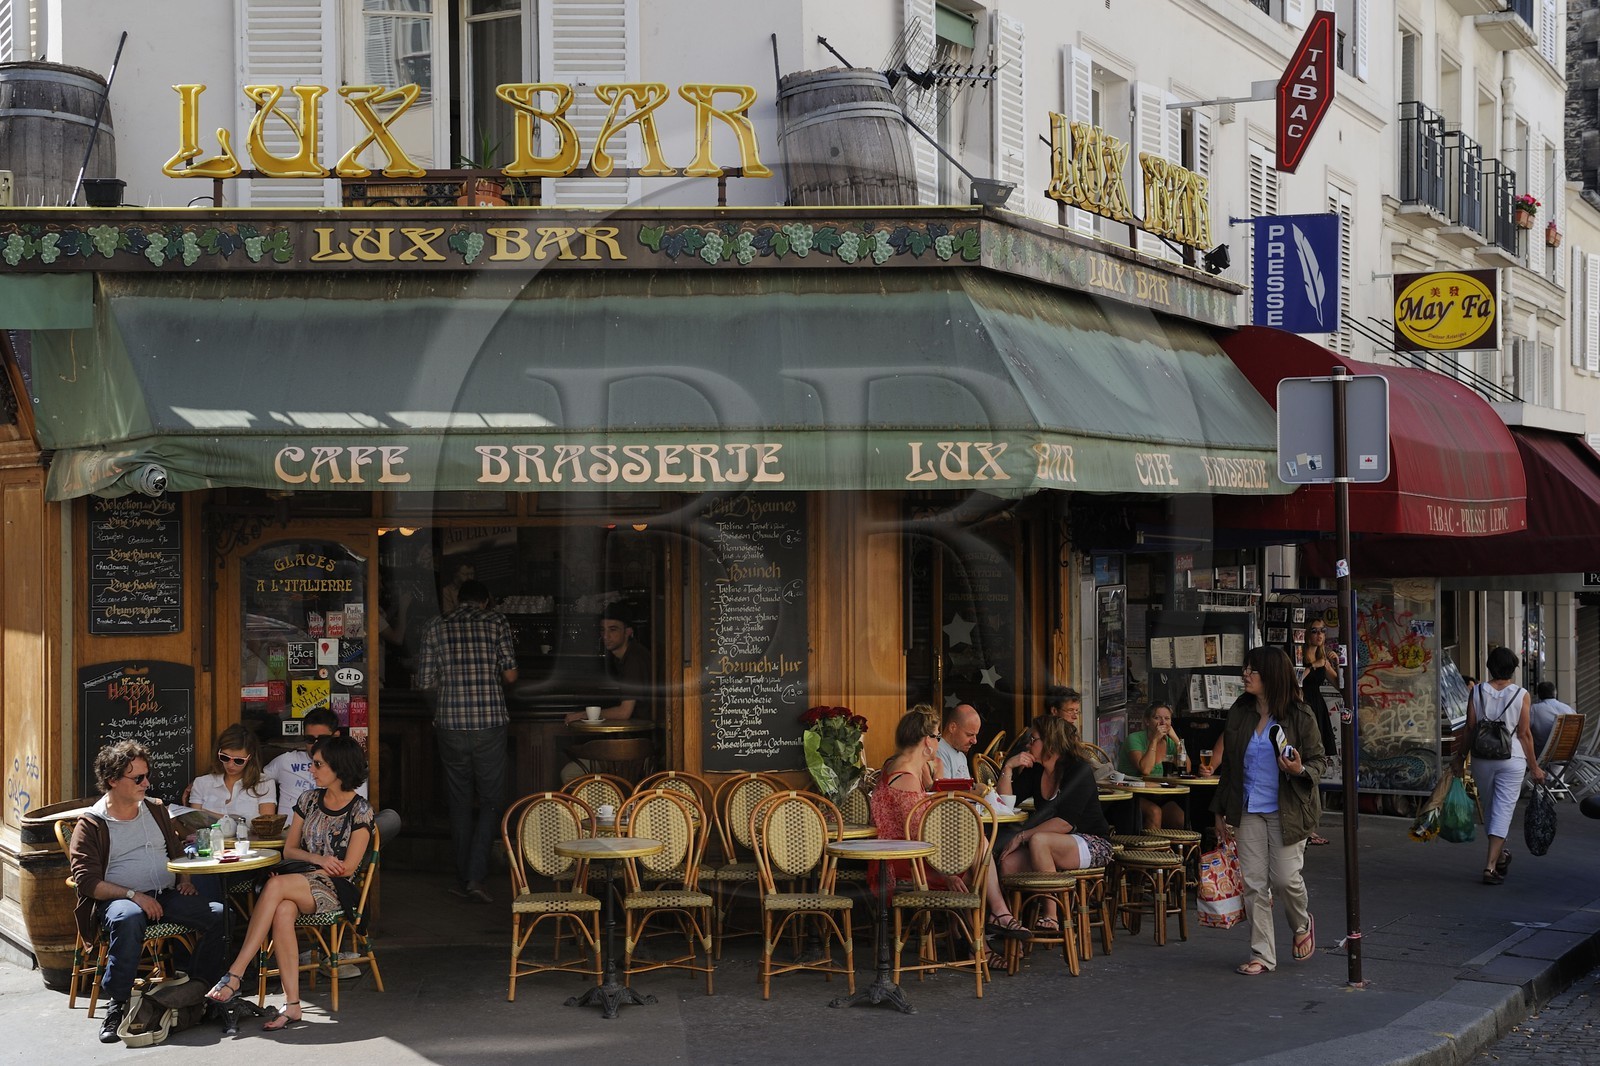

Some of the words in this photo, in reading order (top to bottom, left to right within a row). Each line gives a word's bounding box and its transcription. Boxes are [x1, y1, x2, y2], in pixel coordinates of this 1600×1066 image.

[1287, 48, 1320, 139] TABAC
[162, 83, 427, 178] LUX
[496, 82, 774, 178] BAR
[311, 227, 447, 262] LUX
[488, 226, 627, 262] BAR
[1088, 256, 1129, 295] LUX
[1136, 271, 1171, 307] BAR
[1268, 224, 1285, 327] PRESSE
[1398, 296, 1454, 332] May
[1462, 294, 1491, 318] Fa
[275, 444, 411, 484] CAFE
[475, 443, 784, 484] BRASSERIE
[906, 441, 1010, 482] LUX
[1036, 443, 1077, 482] BAR
[1135, 452, 1179, 487] CAFE
[1207, 454, 1269, 490] BRASSERIE
[1427, 505, 1454, 533] TABAC
[1460, 509, 1486, 533] PRESSE
[1490, 507, 1508, 532] LEPIC
[274, 554, 336, 572] GLACES
[256, 579, 265, 592] A
[271, 579, 352, 592] L'ITALIENNE
[107, 682, 155, 702] Happy
[124, 696, 163, 716] Hour
